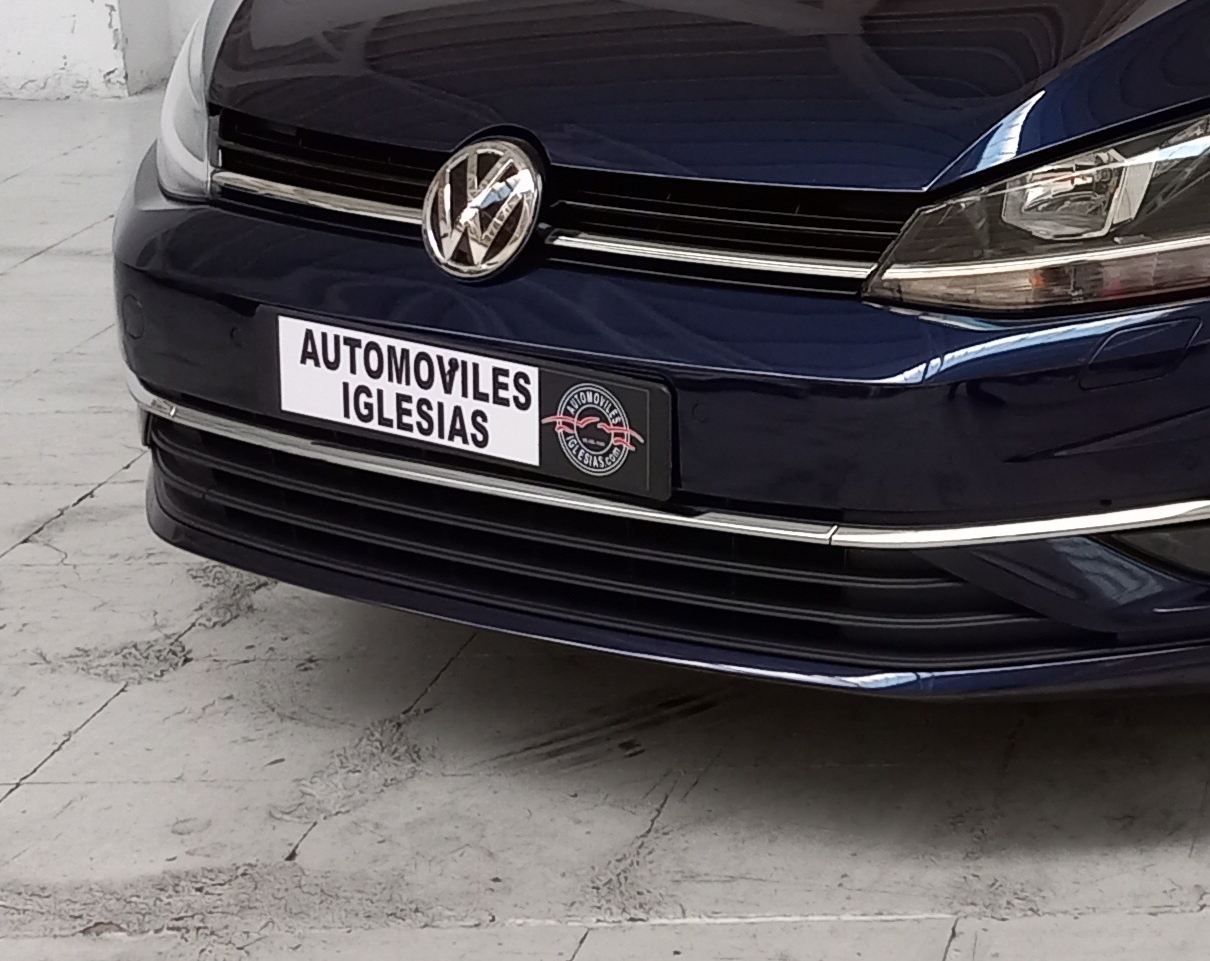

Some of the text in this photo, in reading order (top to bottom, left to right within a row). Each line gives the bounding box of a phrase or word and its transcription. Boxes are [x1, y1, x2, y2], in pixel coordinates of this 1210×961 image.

[300, 328, 532, 411] AUTOMOVILES
[342, 381, 489, 448] IGLESIAS
[566, 390, 622, 425] AUTOMOVILES
